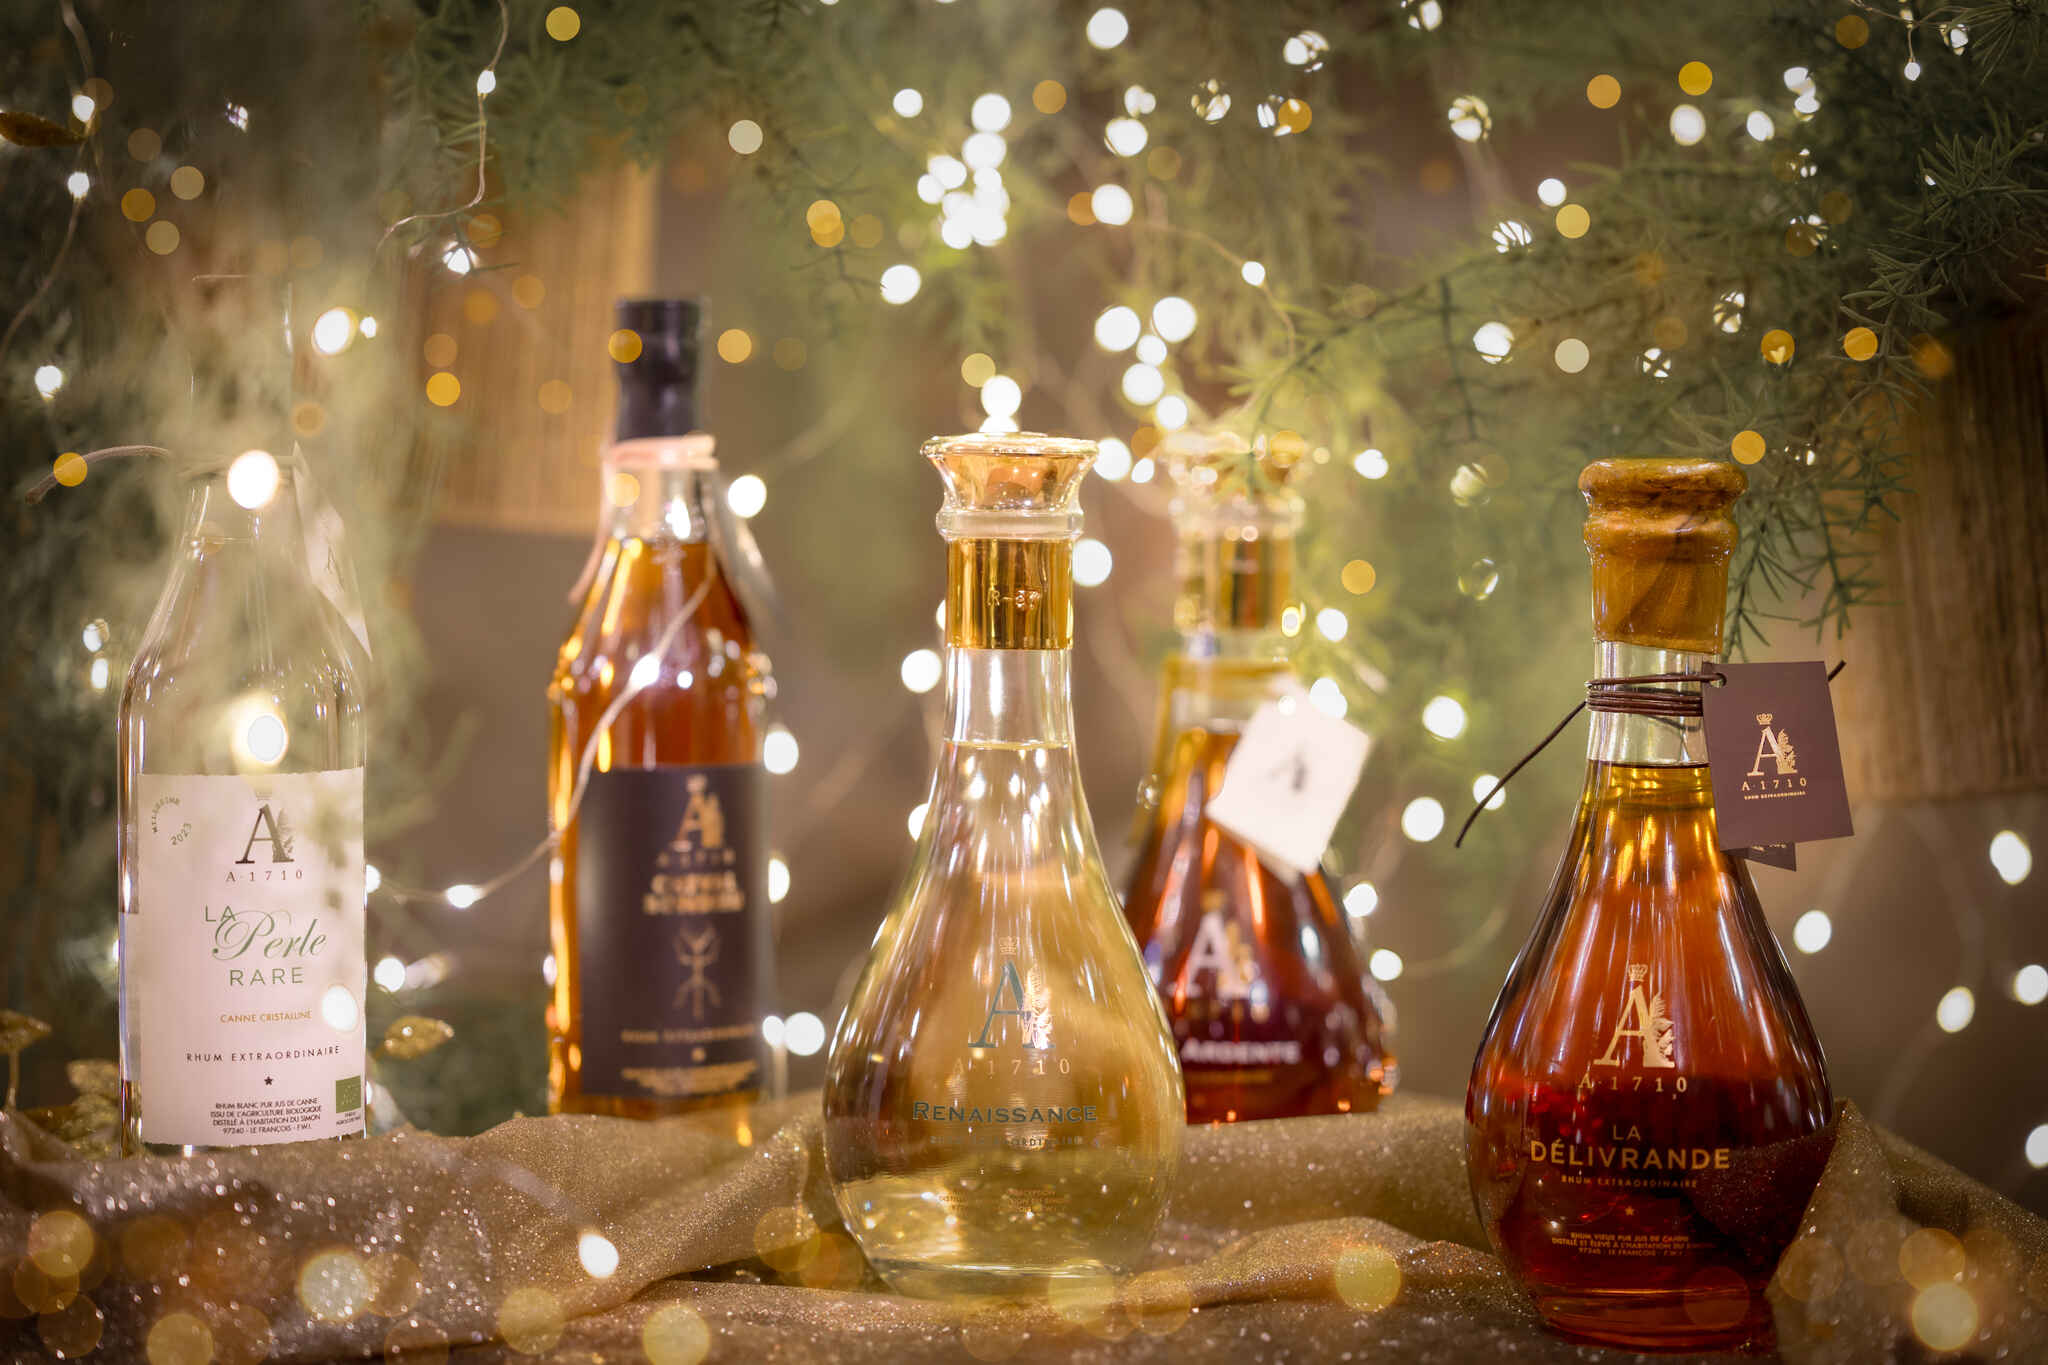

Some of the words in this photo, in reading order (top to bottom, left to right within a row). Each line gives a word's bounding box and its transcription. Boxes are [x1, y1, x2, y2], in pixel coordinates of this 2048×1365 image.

[205, 905, 237, 922] LA
[212, 910, 327, 961] Perle
[229, 967, 304, 987] RARE
[220, 1014, 257, 1024] CANNE
[186, 1052, 223, 1063] RHUM
[231, 1045, 341, 1062] EXTRAORDINAIRE
[912, 1102, 1097, 1122] RENAISSANCE
[1612, 1125, 1641, 1141] LA
[1530, 1139, 1730, 1169] DÉLIVRANDE
